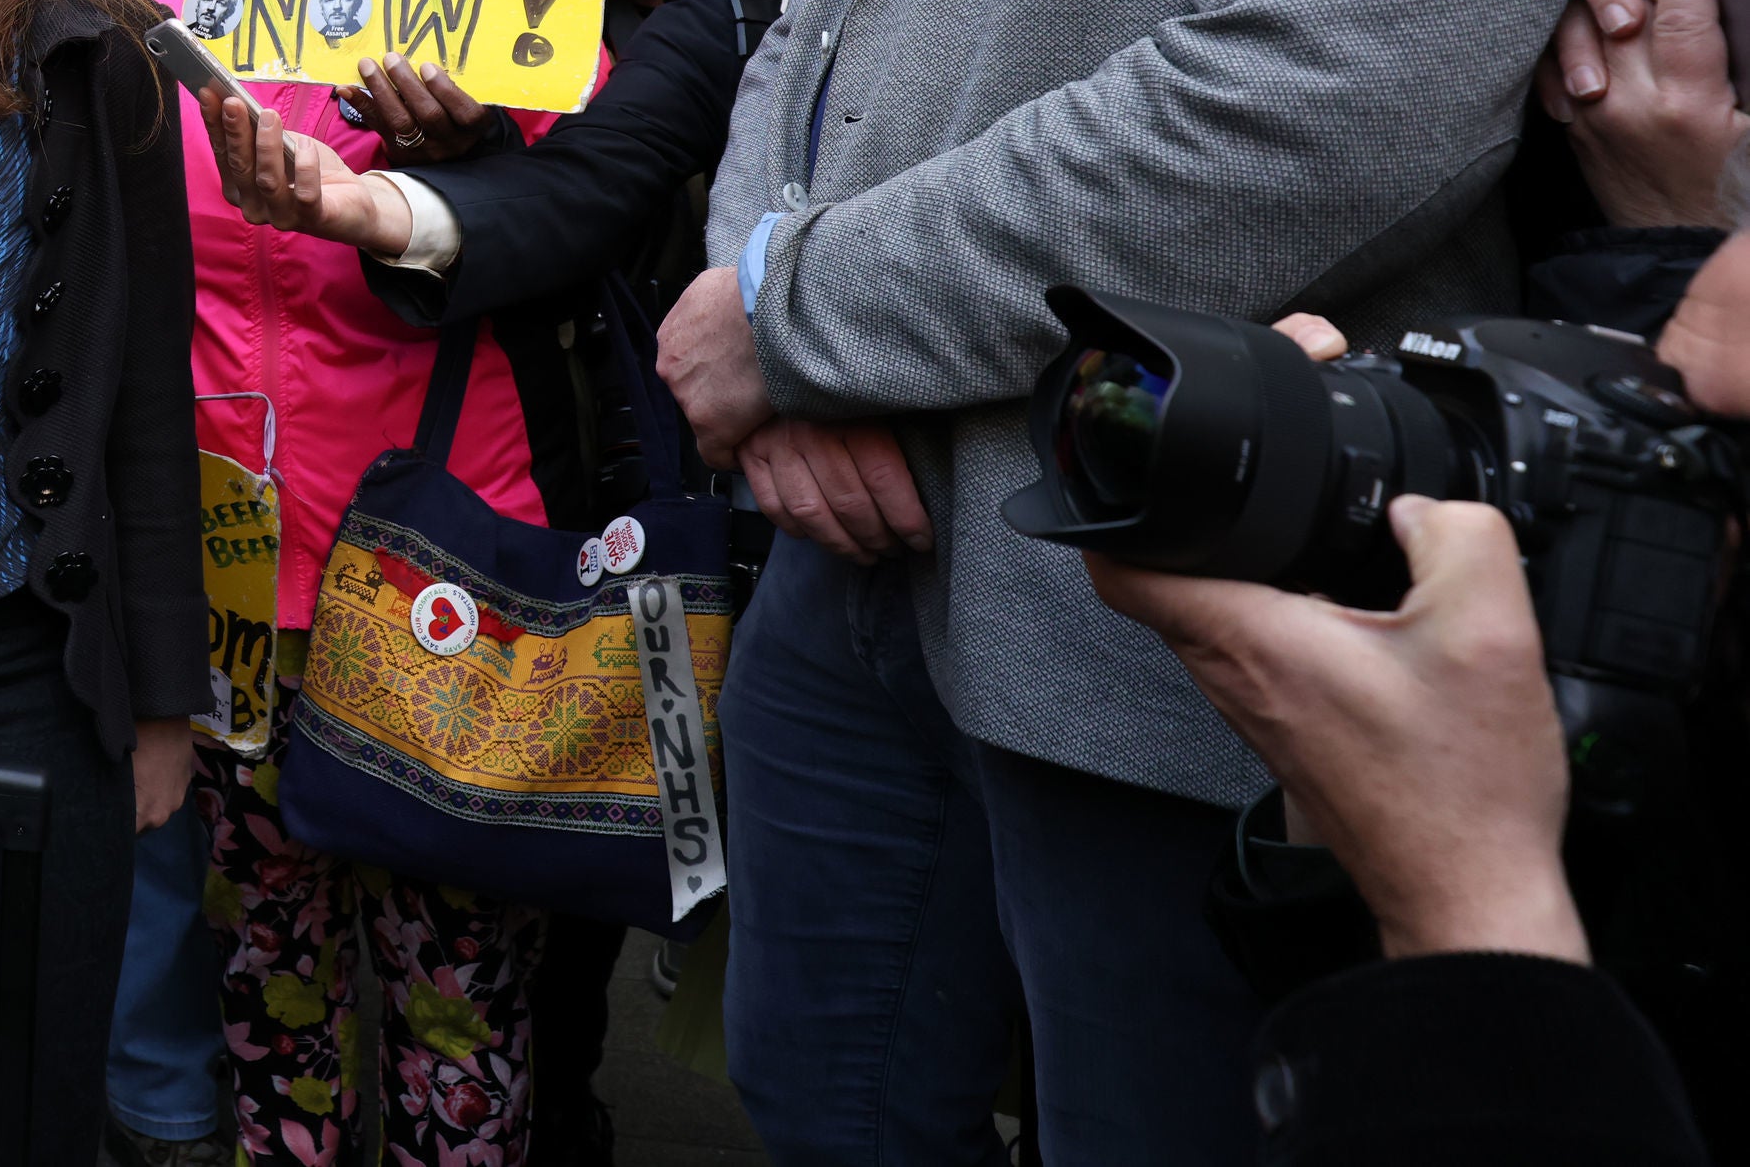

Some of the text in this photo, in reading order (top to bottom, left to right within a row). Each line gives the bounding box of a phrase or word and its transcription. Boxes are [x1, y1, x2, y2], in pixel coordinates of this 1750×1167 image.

[198, 24, 210, 33] Free
[325, 30, 349, 38] Assange
[1400, 331, 1462, 361] Nikon
[605, 530, 621, 567] SAVE
[613, 528, 627, 560] CHARING
[620, 528, 631, 552] CROSS
[624, 519, 639, 554] HOSPITAL
[590, 545, 598, 573] NHS
[415, 588, 447, 651] SAVE OUR HOSPITALS
[444, 590, 476, 653] SAVE OUR HOSPITALS
[639, 579, 709, 866] OUR NHS
